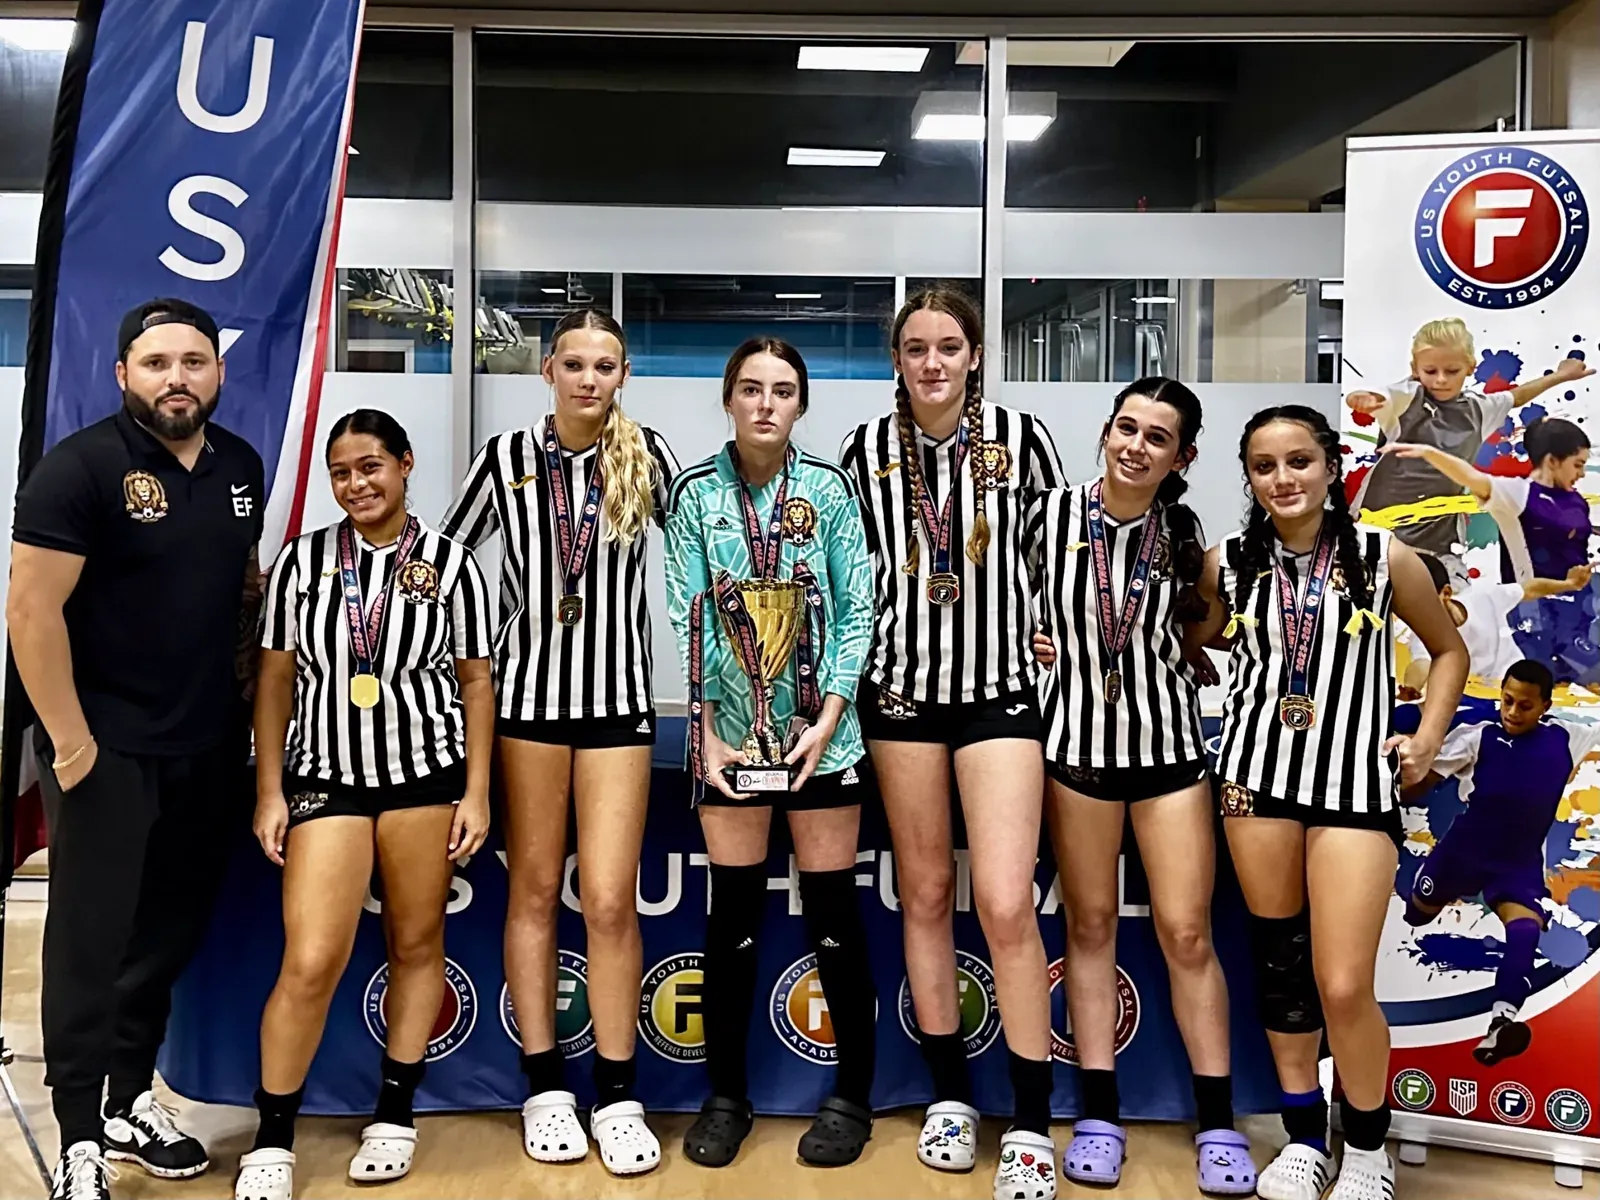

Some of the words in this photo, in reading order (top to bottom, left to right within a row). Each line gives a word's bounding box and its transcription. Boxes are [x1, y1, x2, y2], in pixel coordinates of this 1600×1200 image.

[1420, 207, 1436, 238] US
[1433, 152, 1513, 196] YOUTH
[1527, 156, 1583, 235] FUTSAL
[1474, 188, 1534, 269] F
[1448, 277, 1492, 304] EST.
[1505, 276, 1554, 304] 1994
[232, 497, 253, 517] EF
[571, 519, 592, 576] 2023-2024
[348, 602, 367, 660] 2023-2024
[1295, 612, 1314, 674] 2023-2024
[369, 992, 380, 1012] US
[444, 966, 471, 1012] UTSAL
[641, 994, 651, 1013] US
[649, 959, 698, 985] YOUTH
[776, 993, 786, 1012] US
[784, 958, 818, 985] YOU
[964, 959, 999, 1013] FUTSAL
[1117, 977, 1134, 1017] TSAL
[789, 1034, 838, 1058] ACADE
[1451, 1080, 1476, 1096] USA
